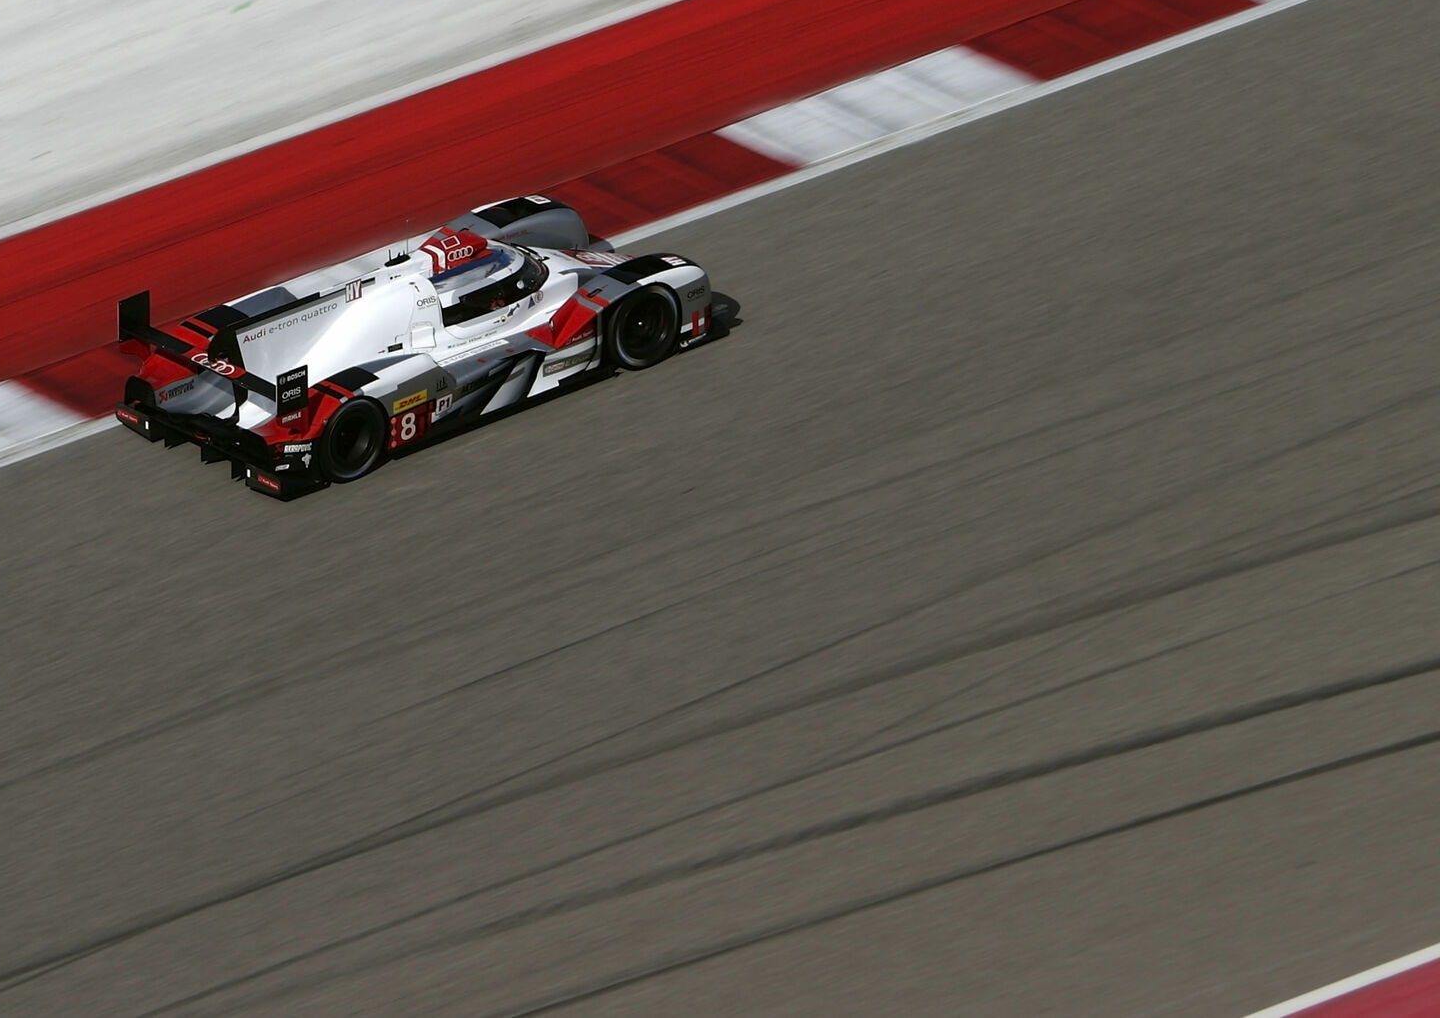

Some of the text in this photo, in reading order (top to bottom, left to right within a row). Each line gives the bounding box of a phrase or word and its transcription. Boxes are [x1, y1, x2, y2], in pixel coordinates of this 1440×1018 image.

[345, 279, 362, 302] HY
[416, 295, 437, 307] ORIS
[243, 302, 338, 343] Audi e-tron quattro
[287, 370, 306, 382] BOSCH
[282, 386, 302, 399] ORIS
[398, 394, 422, 409] DHL
[439, 397, 450, 412] P1
[401, 412, 416, 441] 8
